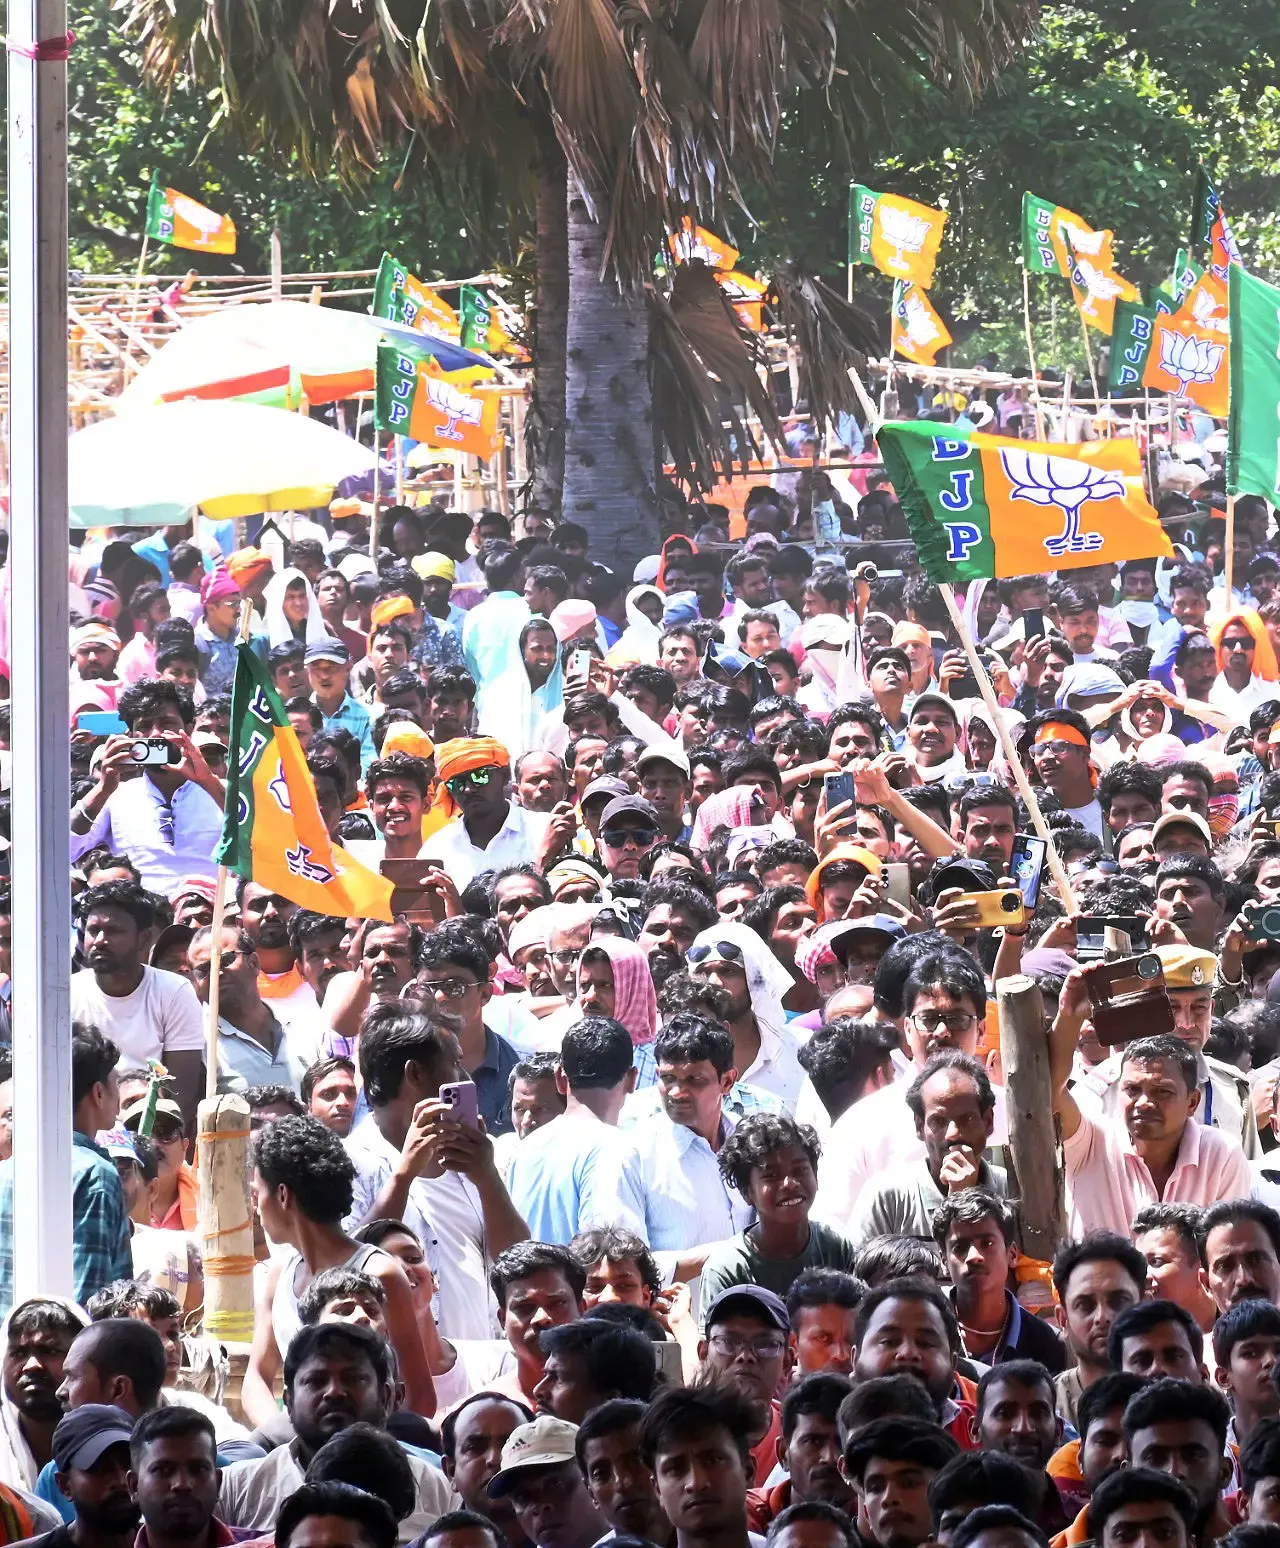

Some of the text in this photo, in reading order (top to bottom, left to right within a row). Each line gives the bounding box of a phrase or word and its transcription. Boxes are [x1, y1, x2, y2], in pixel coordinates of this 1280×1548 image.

[860, 194, 875, 254] BJP
[1119, 315, 1152, 385] BJP
[389, 353, 416, 424] BJP
[931, 436, 982, 561] BJP
